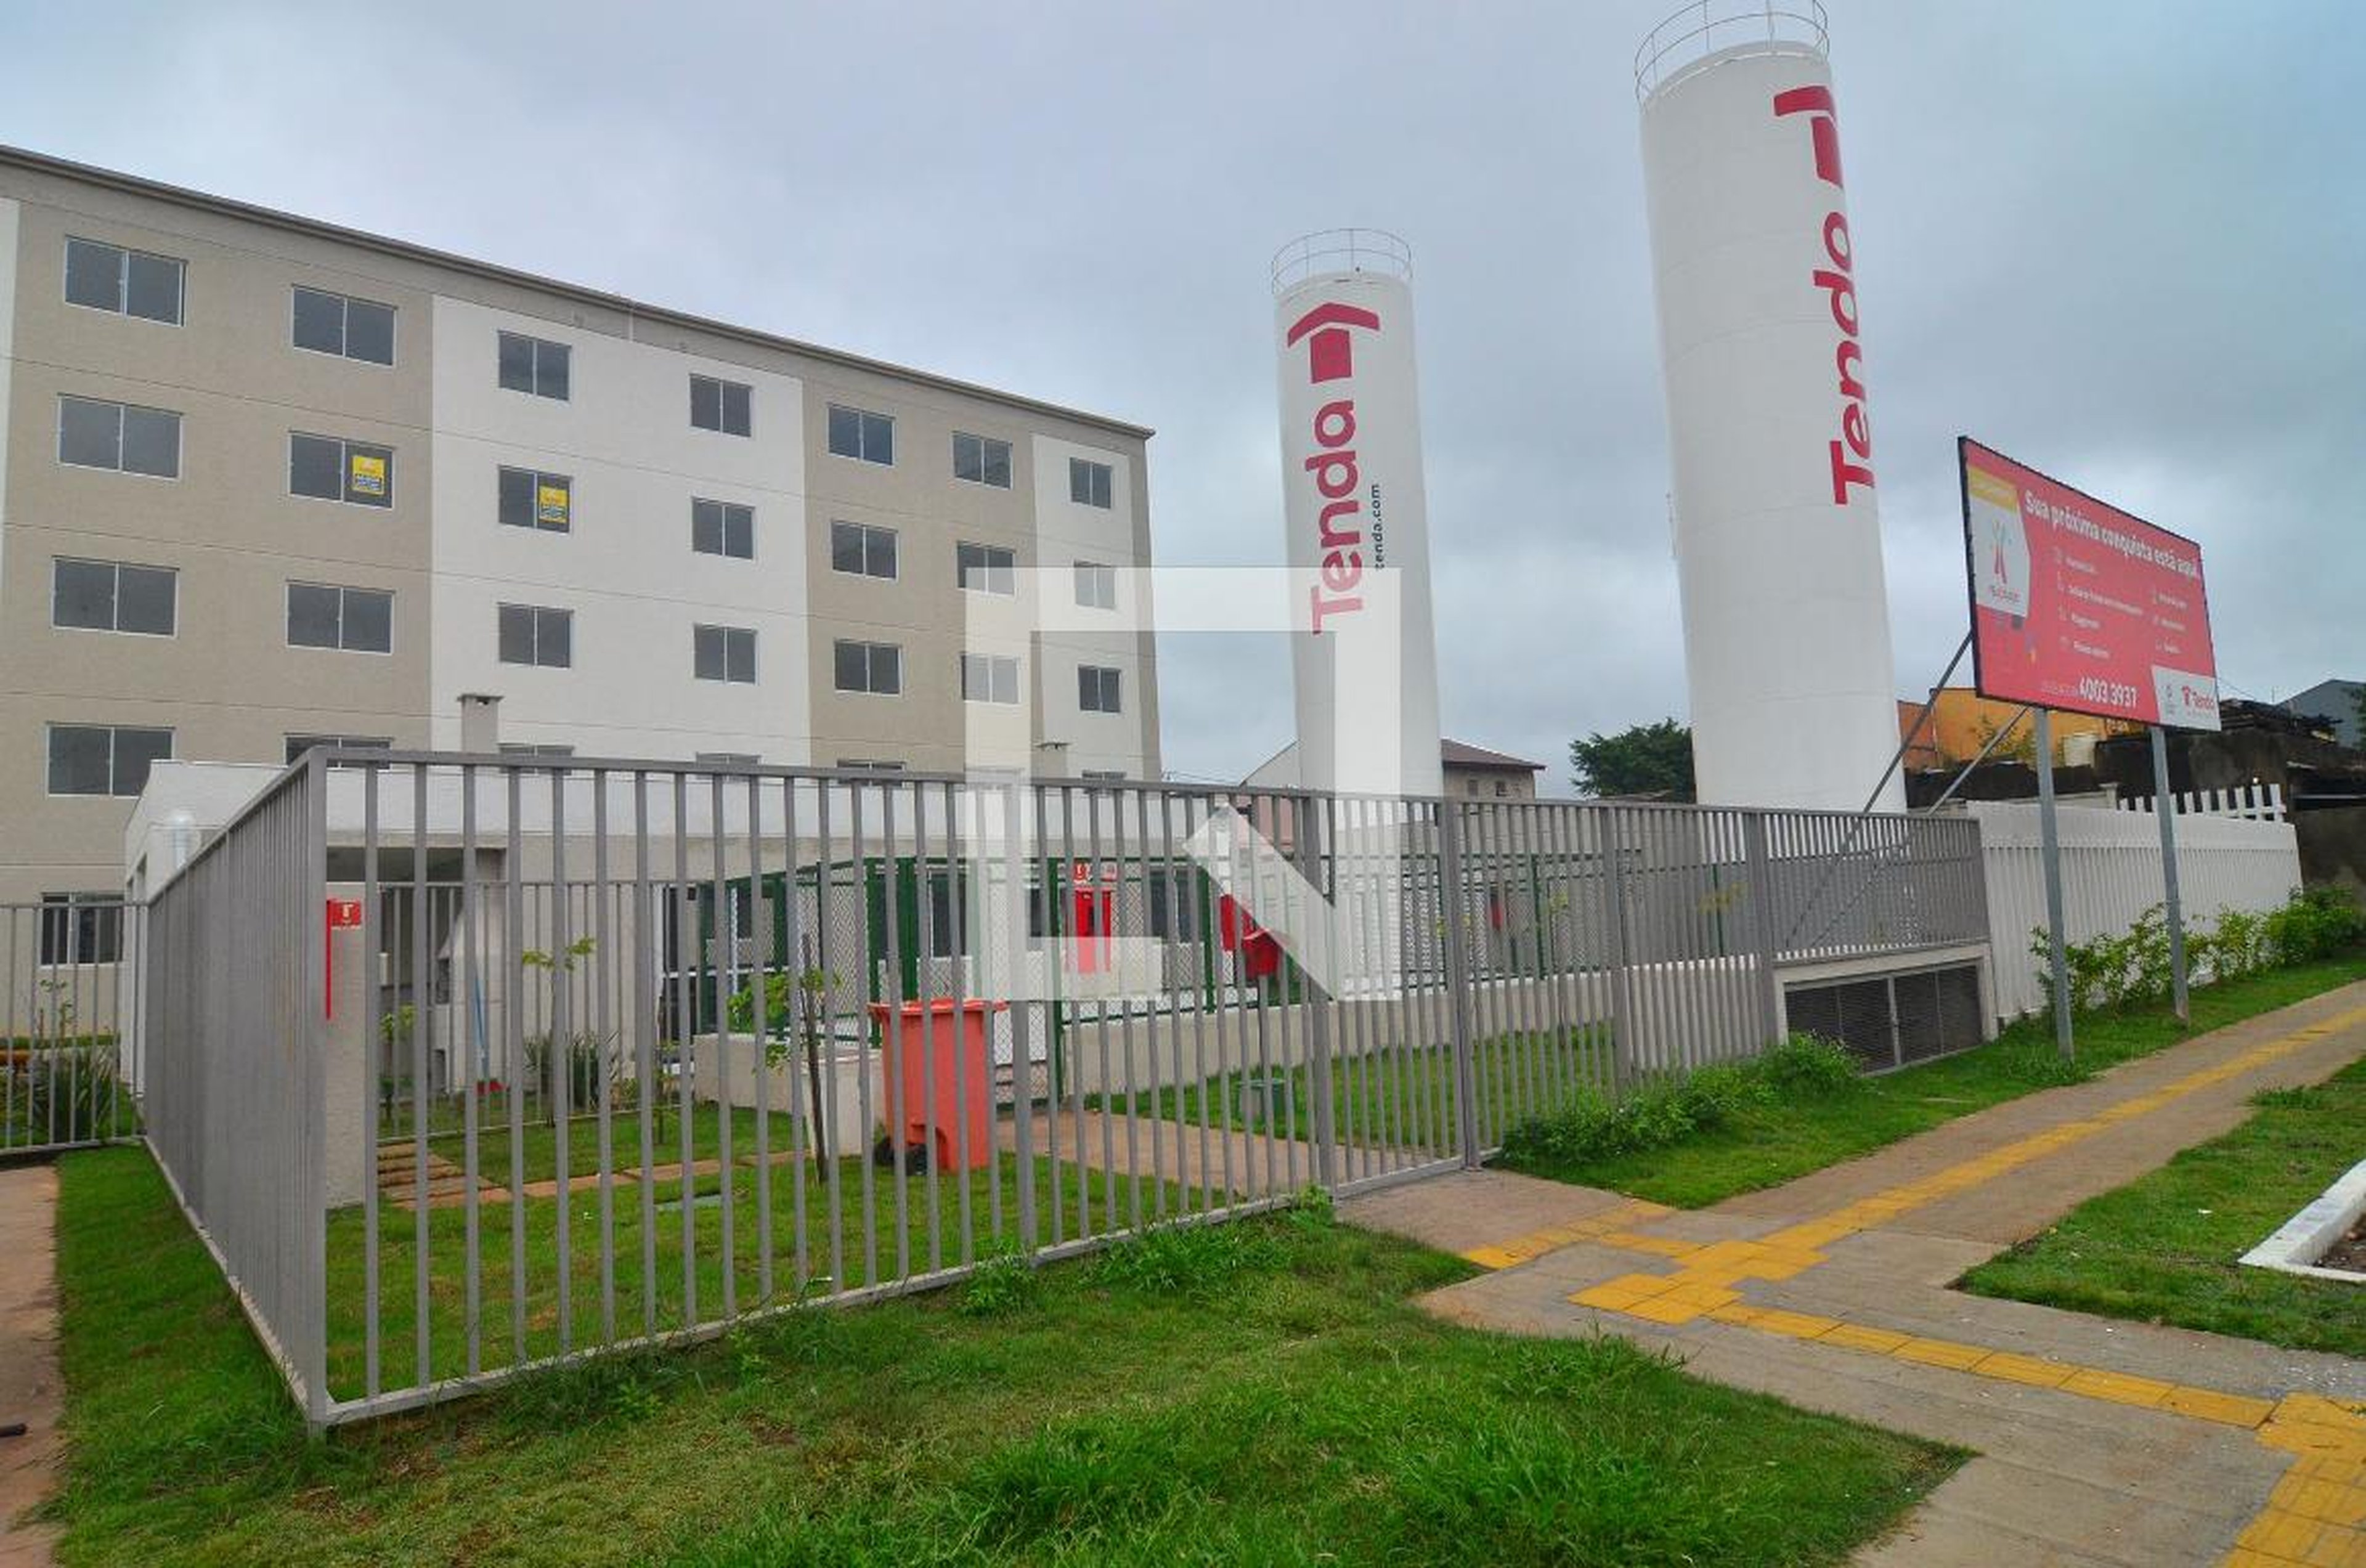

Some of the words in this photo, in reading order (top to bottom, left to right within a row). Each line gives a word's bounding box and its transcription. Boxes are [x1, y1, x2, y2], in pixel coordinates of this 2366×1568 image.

[1812, 211, 1875, 505] Tenda
[1304, 399, 1364, 635] Tenda
[2025, 489, 2049, 519] Sua
[2051, 505, 2099, 540] próxima
[2101, 527, 2153, 562] conquista
[2190, 691, 2214, 710] Tenda
